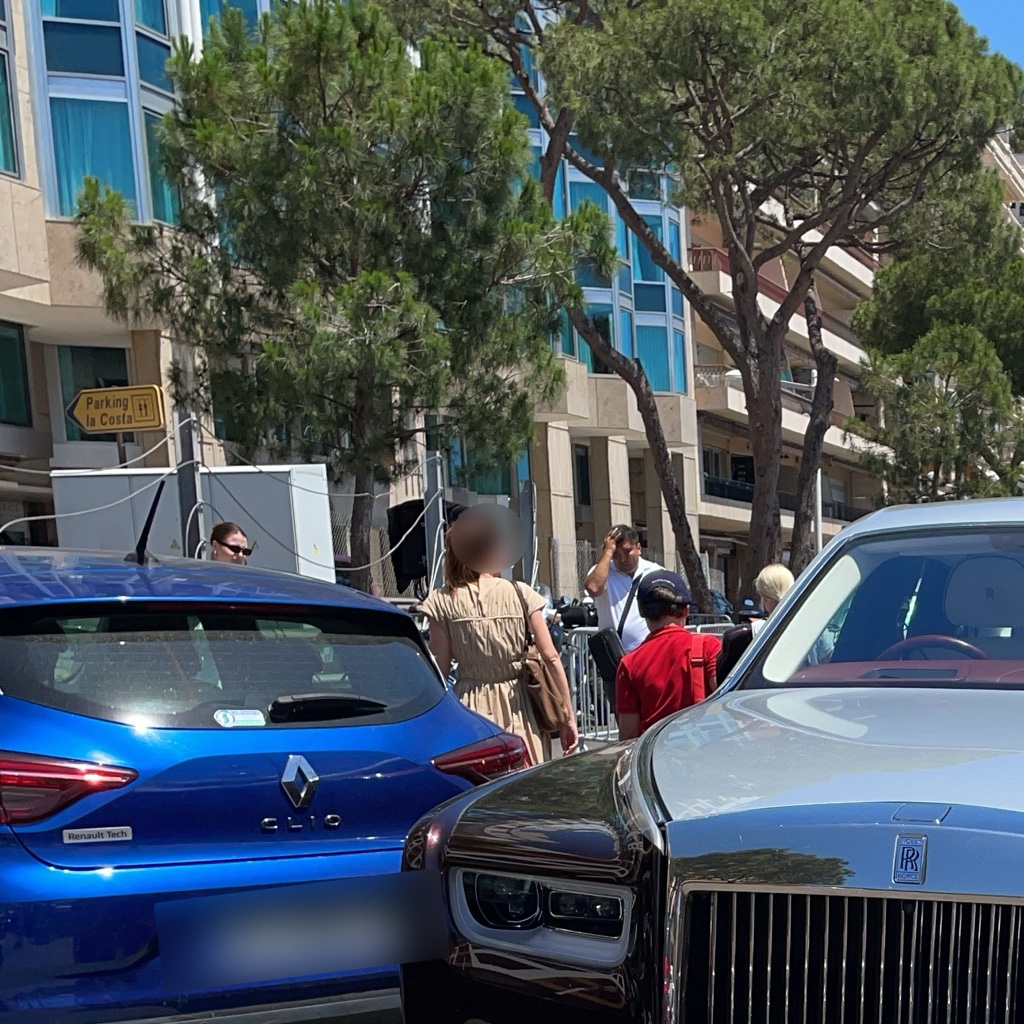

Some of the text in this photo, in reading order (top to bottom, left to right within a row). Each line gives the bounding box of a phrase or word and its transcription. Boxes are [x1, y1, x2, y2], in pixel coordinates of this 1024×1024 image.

[86, 395, 129, 411] Parking
[86, 412, 133, 427] la Costa
[260, 814, 342, 830] CLIO
[68, 830, 128, 841] Renault Tech
